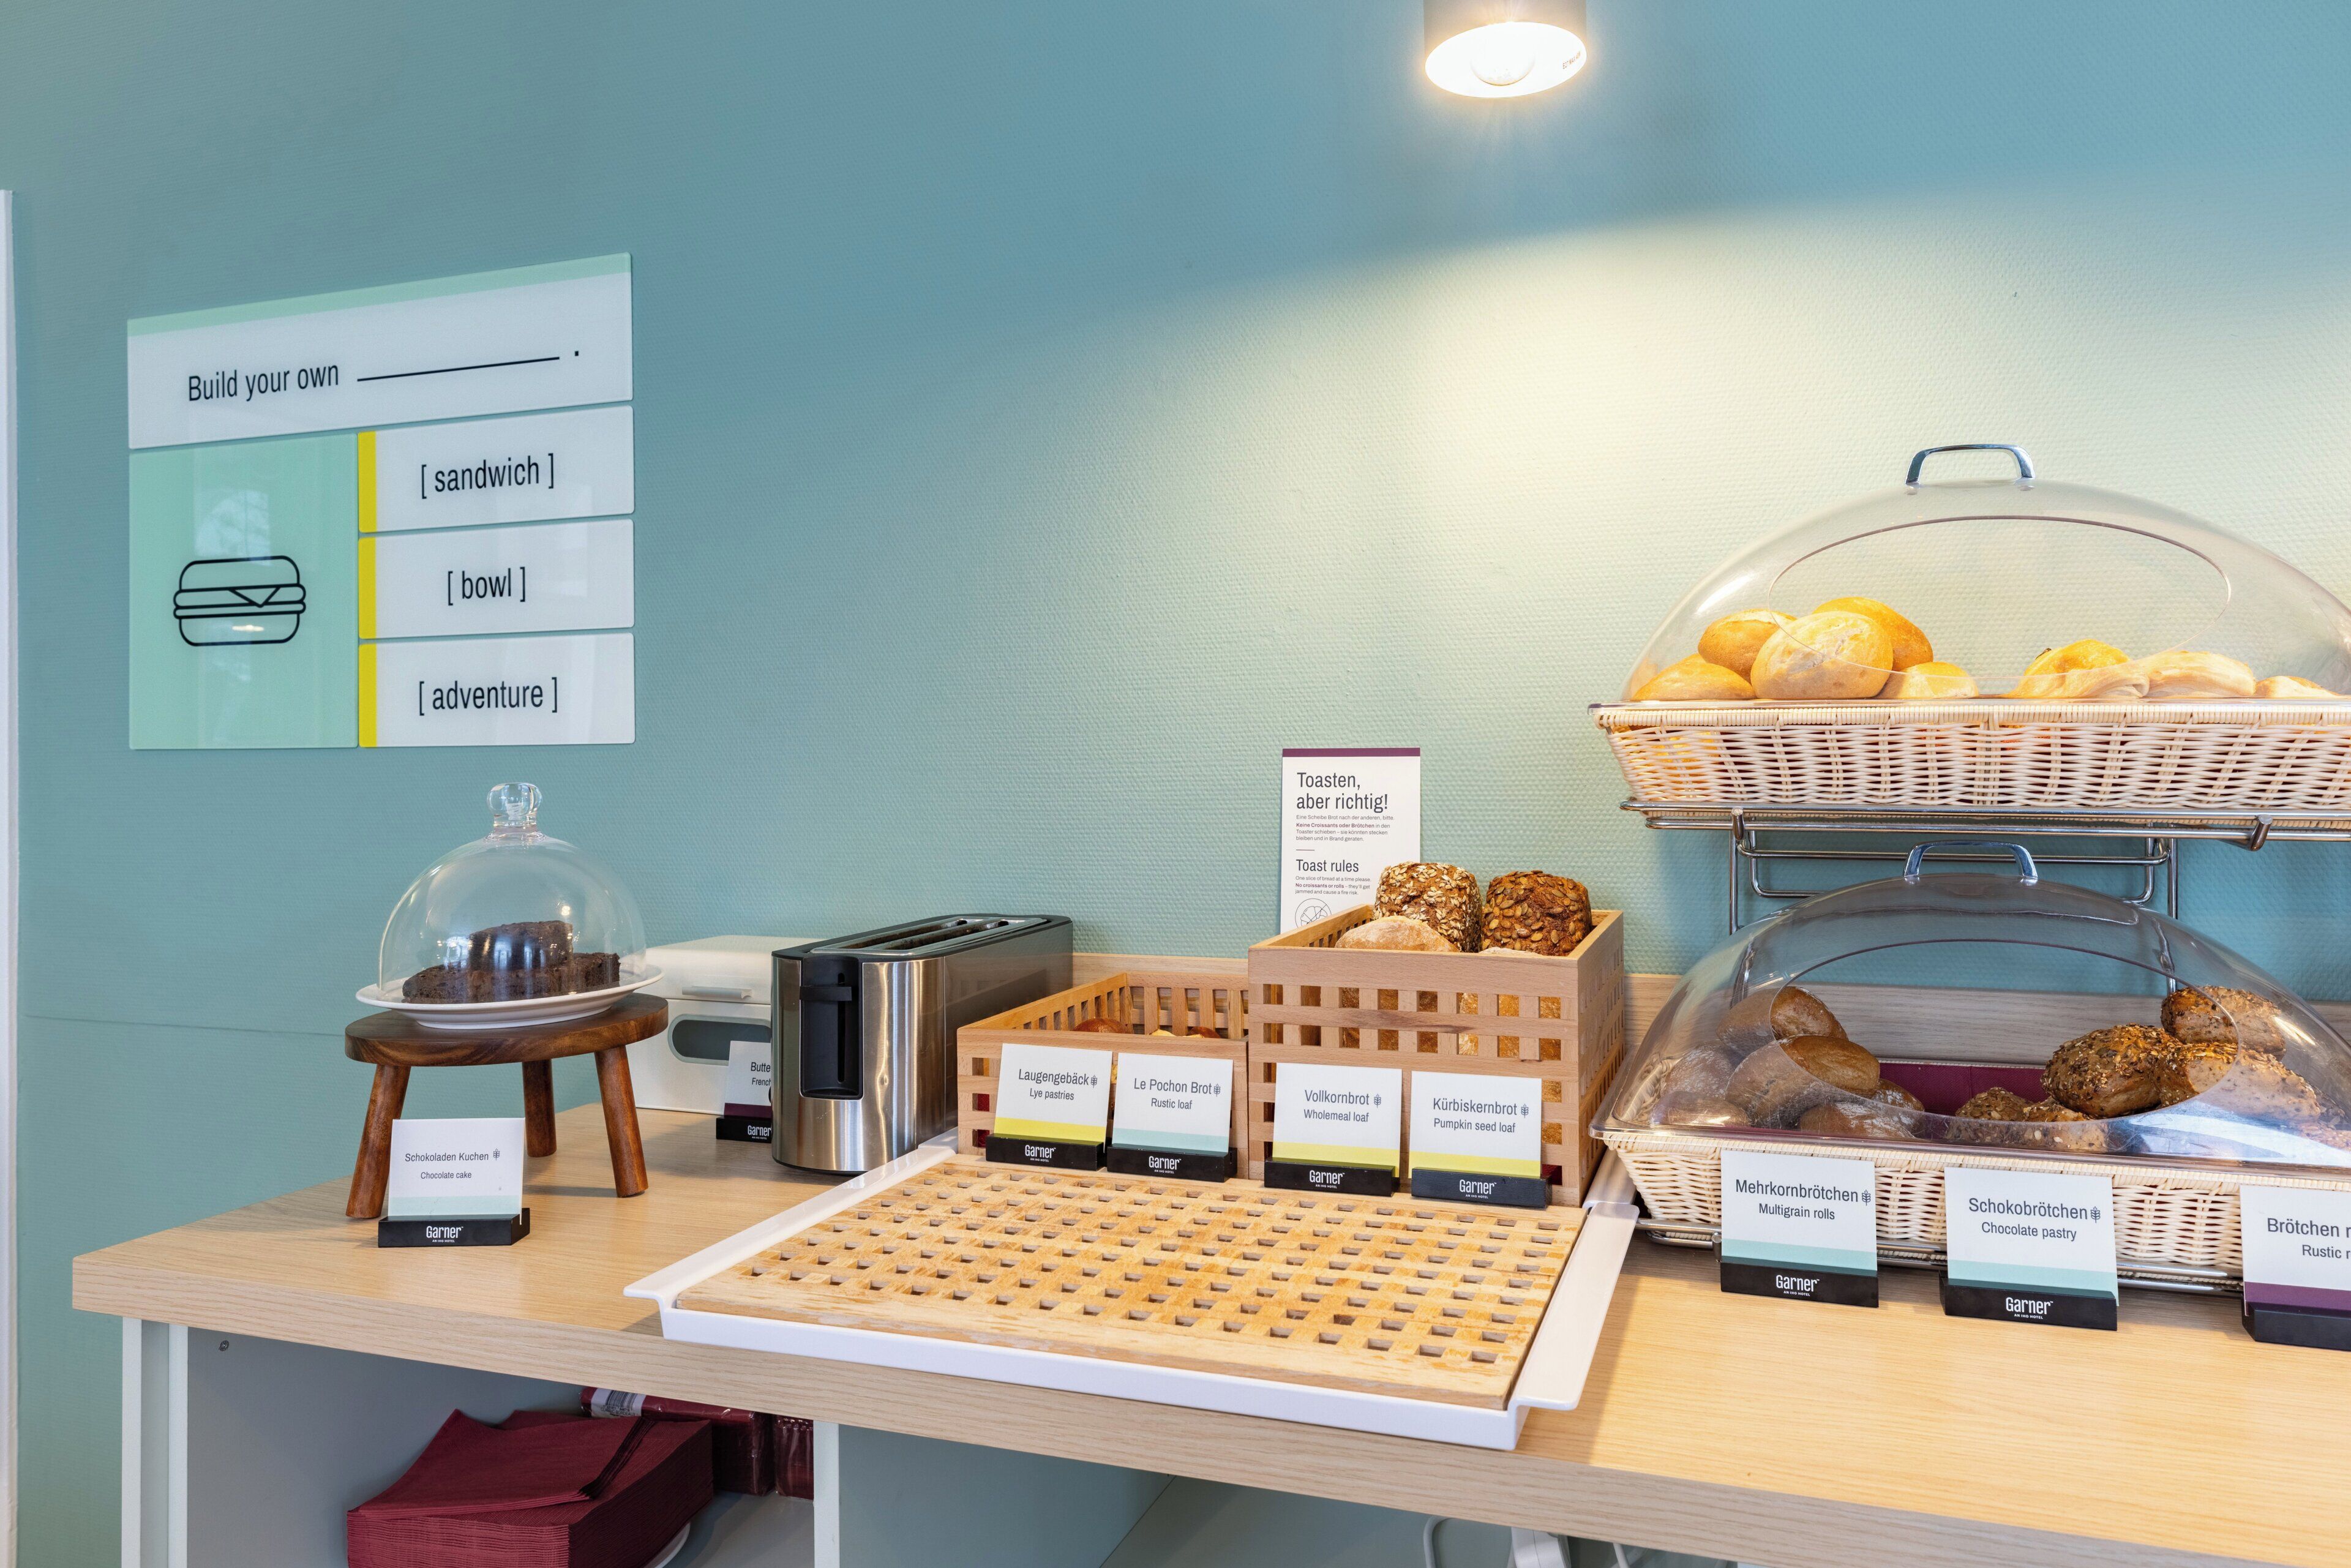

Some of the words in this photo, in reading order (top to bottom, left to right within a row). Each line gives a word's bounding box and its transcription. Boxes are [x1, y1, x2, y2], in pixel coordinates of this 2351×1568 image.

[188, 370, 238, 402] Build
[246, 367, 290, 401] your
[298, 362, 339, 390] own
[1297, 772, 1360, 790] Toasten,
[1297, 793, 1330, 809] aber
[1335, 793, 1388, 813] richtig!
[1295, 859, 1327, 872] Toast
[1331, 860, 1359, 872] rules
[1018, 1068, 1089, 1086] Laugengebäck
[1030, 1087, 1043, 1099] Lye
[1044, 1090, 1075, 1101] pastries
[1134, 1078, 1146, 1090] Le
[1149, 1079, 1188, 1093] Pochon
[1190, 1081, 1212, 1095] Brot
[1151, 1097, 1176, 1109] Rustic
[1178, 1099, 1193, 1110] loaf
[1304, 1089, 1370, 1106] Vollkornbrot
[1433, 1097, 1518, 1116] Kürbiskernbrot
[1303, 1108, 1351, 1122] Wholemeal
[1353, 1111, 1370, 1123] loaf
[1434, 1117, 1472, 1131] Pumpkin
[1474, 1119, 1497, 1132] seed
[1499, 1121, 1517, 1134] loaf
[405, 1152, 456, 1162] Schokoladen
[459, 1152, 489, 1161] Kuchen
[456, 1171, 472, 1179] cake
[1735, 1179, 1859, 1203] Mehrkornbrötchen
[1758, 1202, 1811, 1219] Multigrain
[1813, 1207, 1835, 1221] rolls
[1969, 1197, 2088, 1220] Schokobrötchen
[1981, 1221, 2039, 1237] Chocolate
[2042, 1225, 2077, 1242] pastry
[2268, 1217, 2340, 1237] Brötchen
[2302, 1244, 2341, 1259] Rustic
